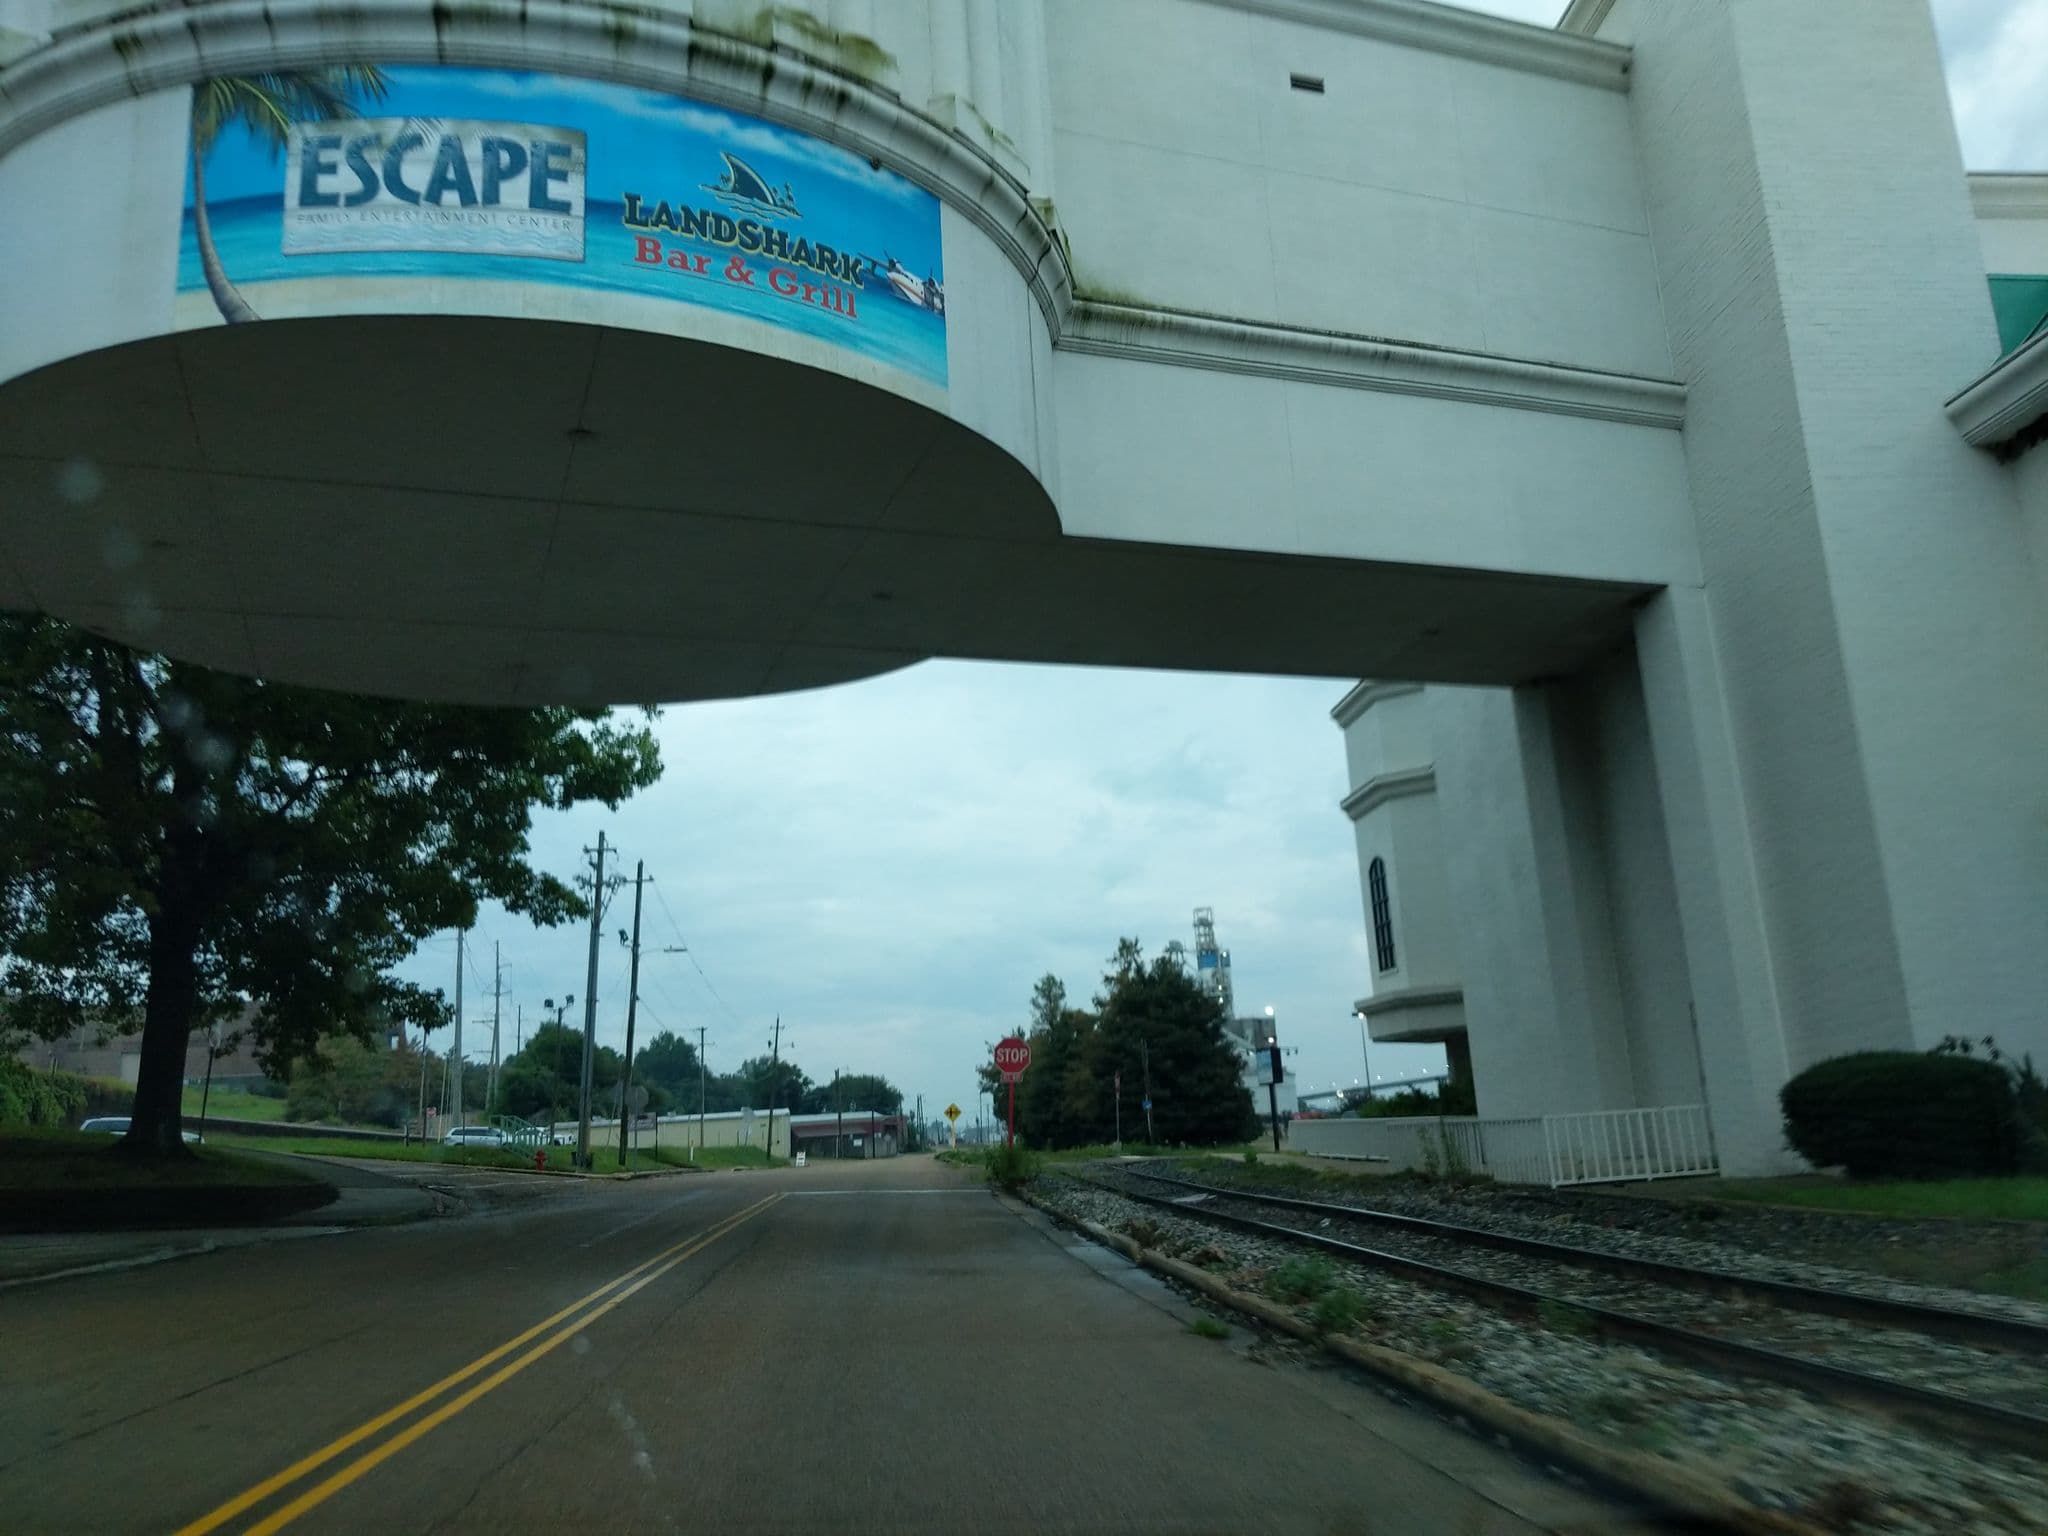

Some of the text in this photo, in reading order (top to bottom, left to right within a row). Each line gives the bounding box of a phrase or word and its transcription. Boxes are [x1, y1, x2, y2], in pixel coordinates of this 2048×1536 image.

[299, 133, 572, 214] ESCAPE
[506, 214, 571, 231] CENTER
[623, 193, 865, 288] LANDSHARK
[635, 236, 857, 318] Bar & Grill
[996, 1047, 1028, 1064] STOP
